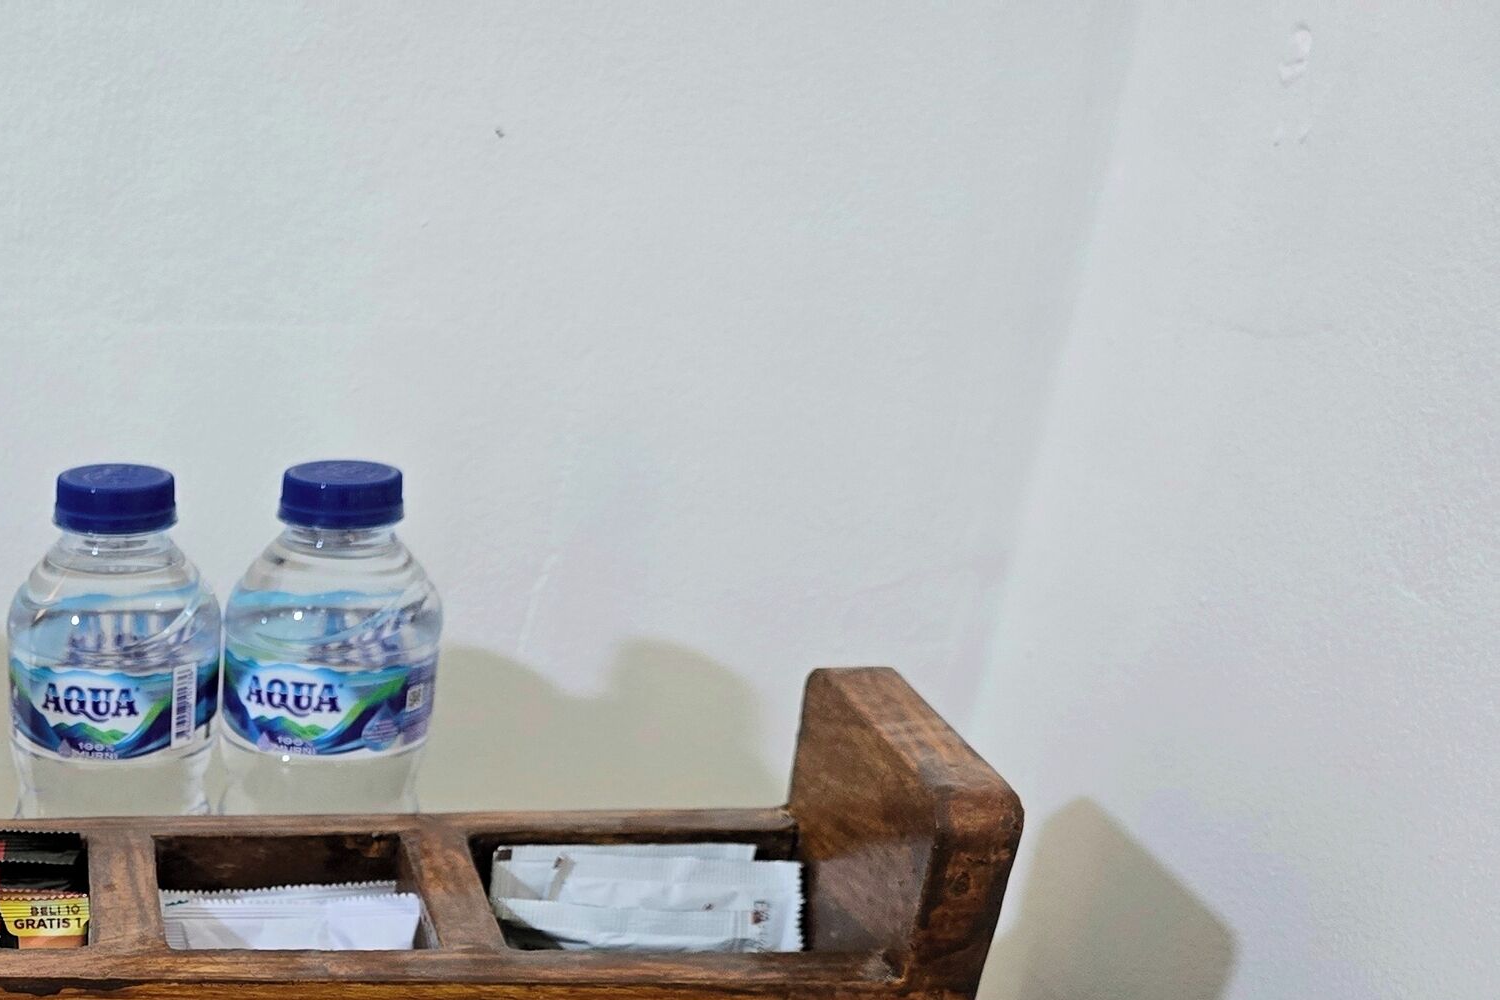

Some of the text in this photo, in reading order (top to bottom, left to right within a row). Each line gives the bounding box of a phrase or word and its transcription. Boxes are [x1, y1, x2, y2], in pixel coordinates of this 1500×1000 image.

[41, 683, 139, 722] AQUA
[246, 675, 341, 717] AQUA
[13, 917, 82, 930] GRATIS 1
[30, 904, 80, 917] BELI 10
